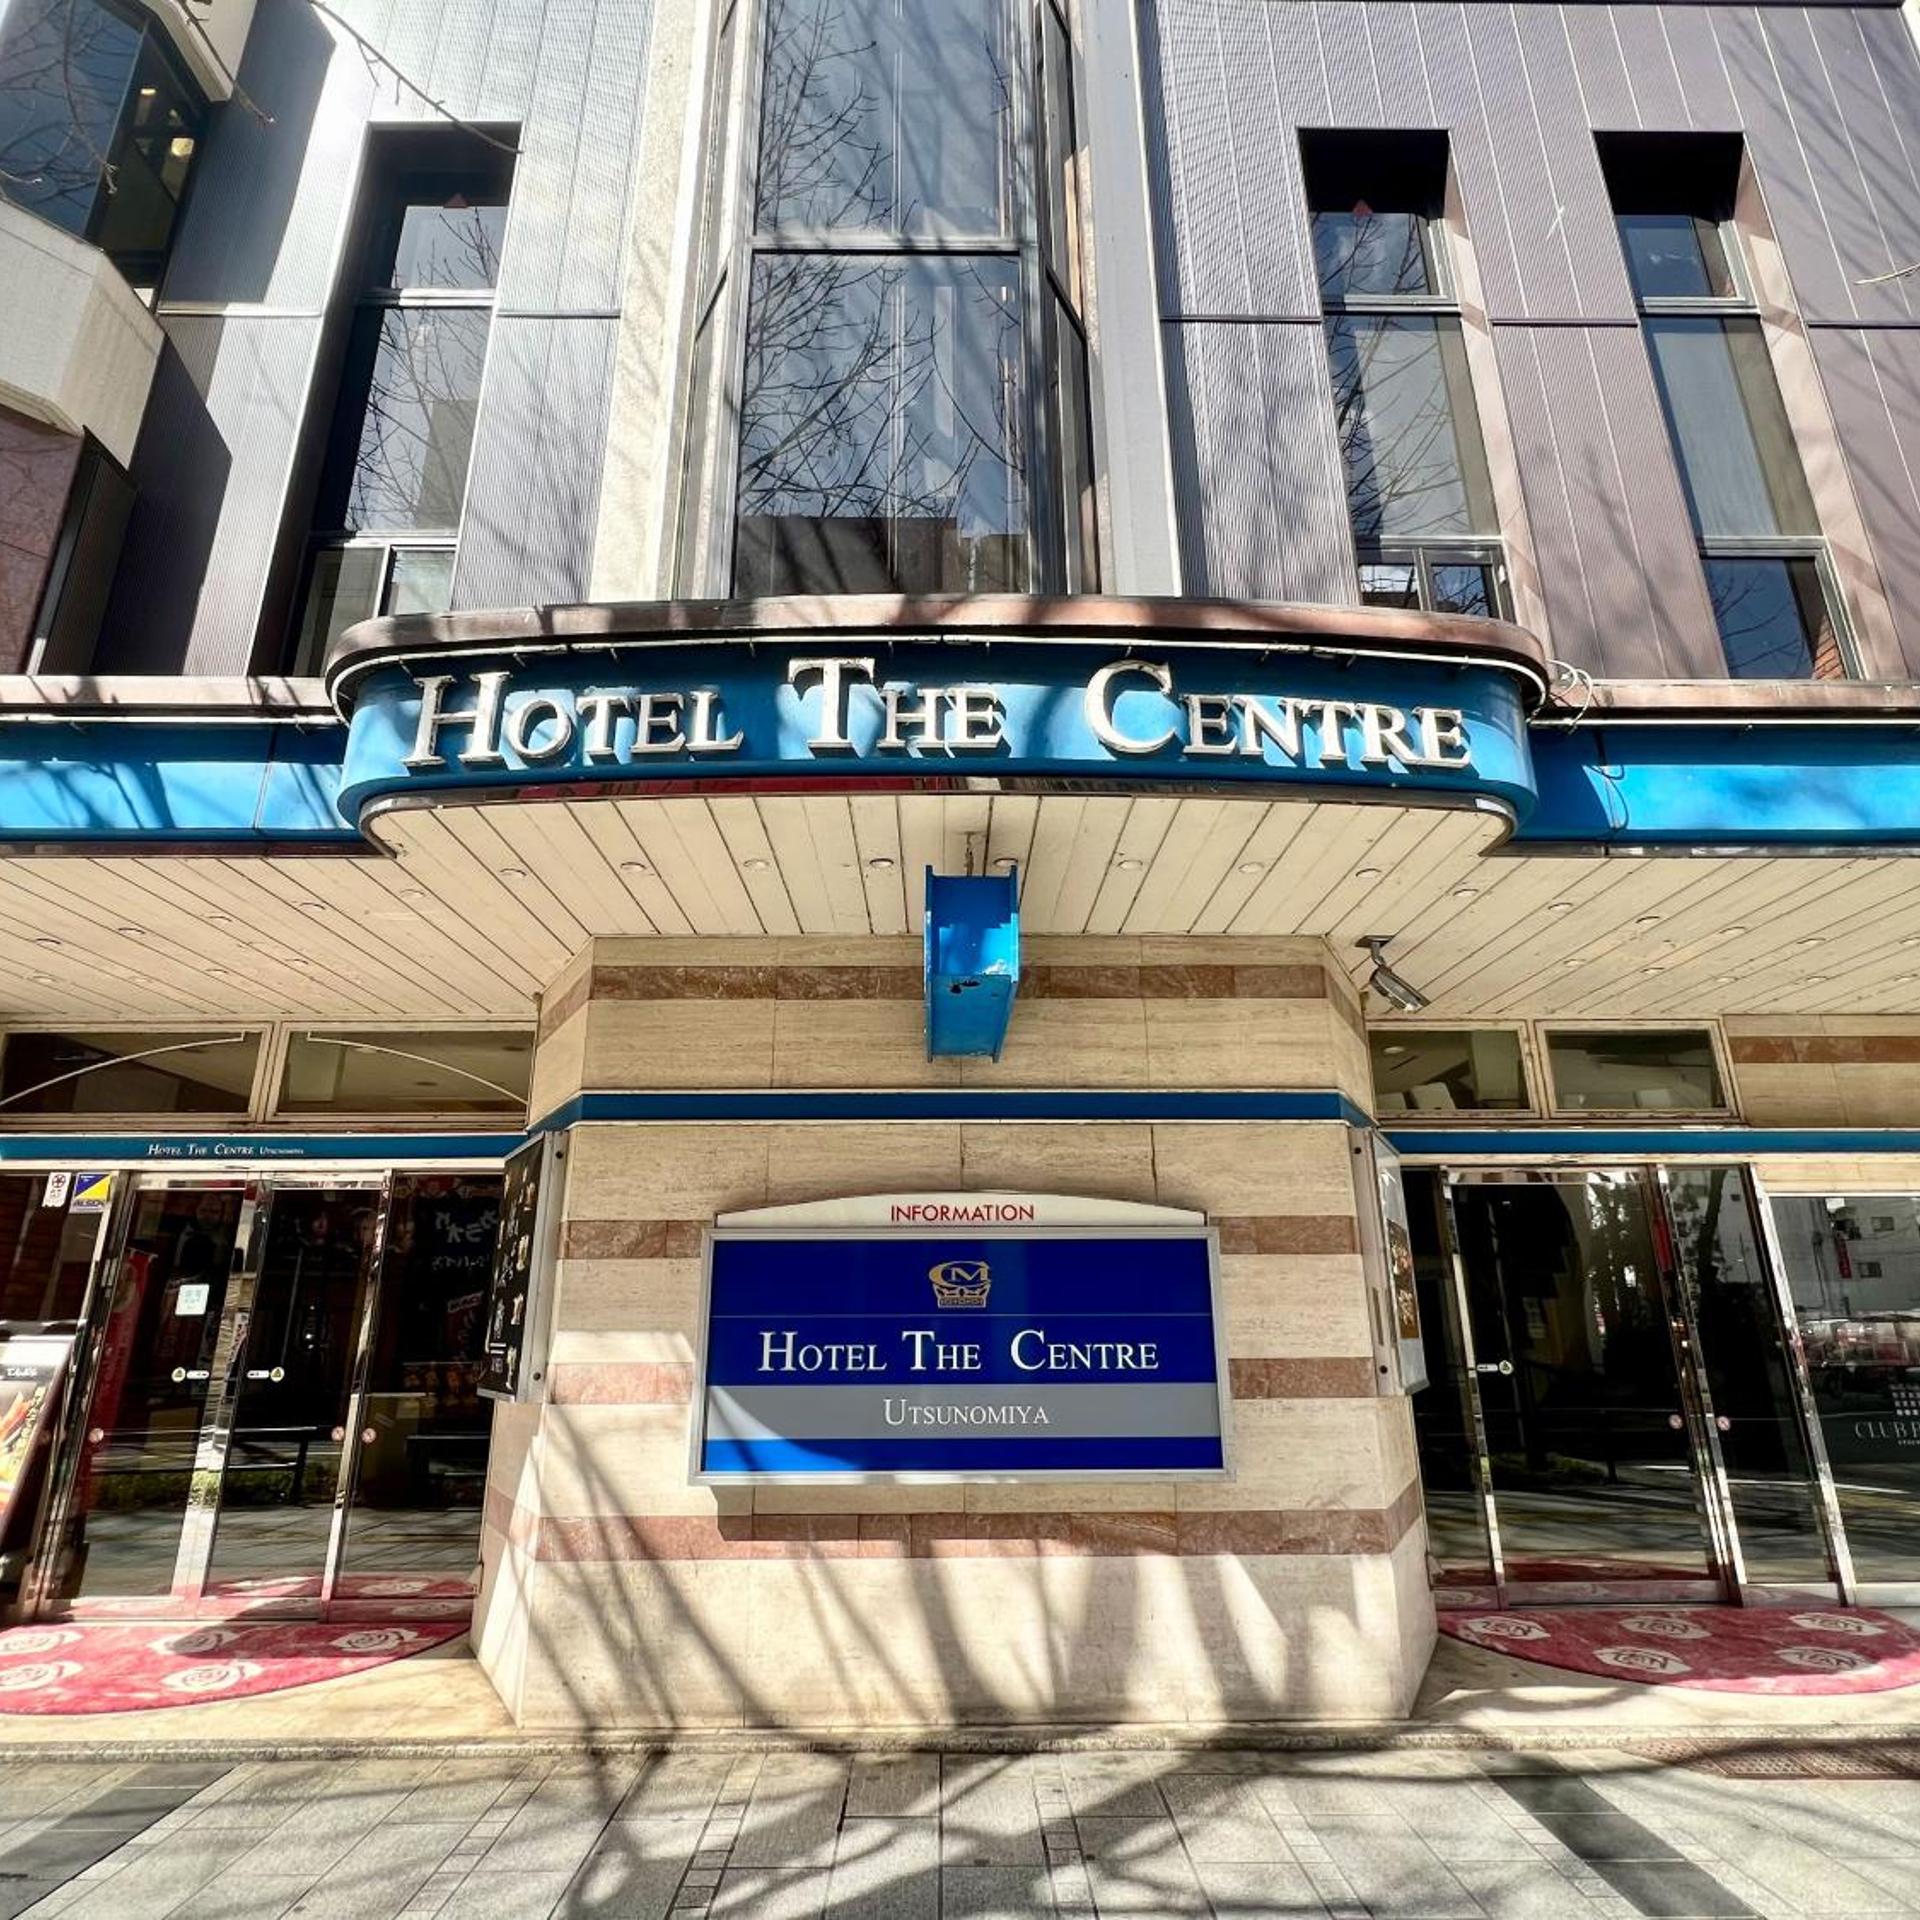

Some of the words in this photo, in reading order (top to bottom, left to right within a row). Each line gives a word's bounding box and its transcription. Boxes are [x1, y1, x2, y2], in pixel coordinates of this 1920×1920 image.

[890, 1205, 1034, 1222] INFORMATION
[757, 1331, 887, 1372] HOTEL
[902, 1330, 981, 1371] THE
[1010, 1329, 1159, 1371] CENTRE
[883, 1398, 1050, 1425] UTSUNOMIYA
